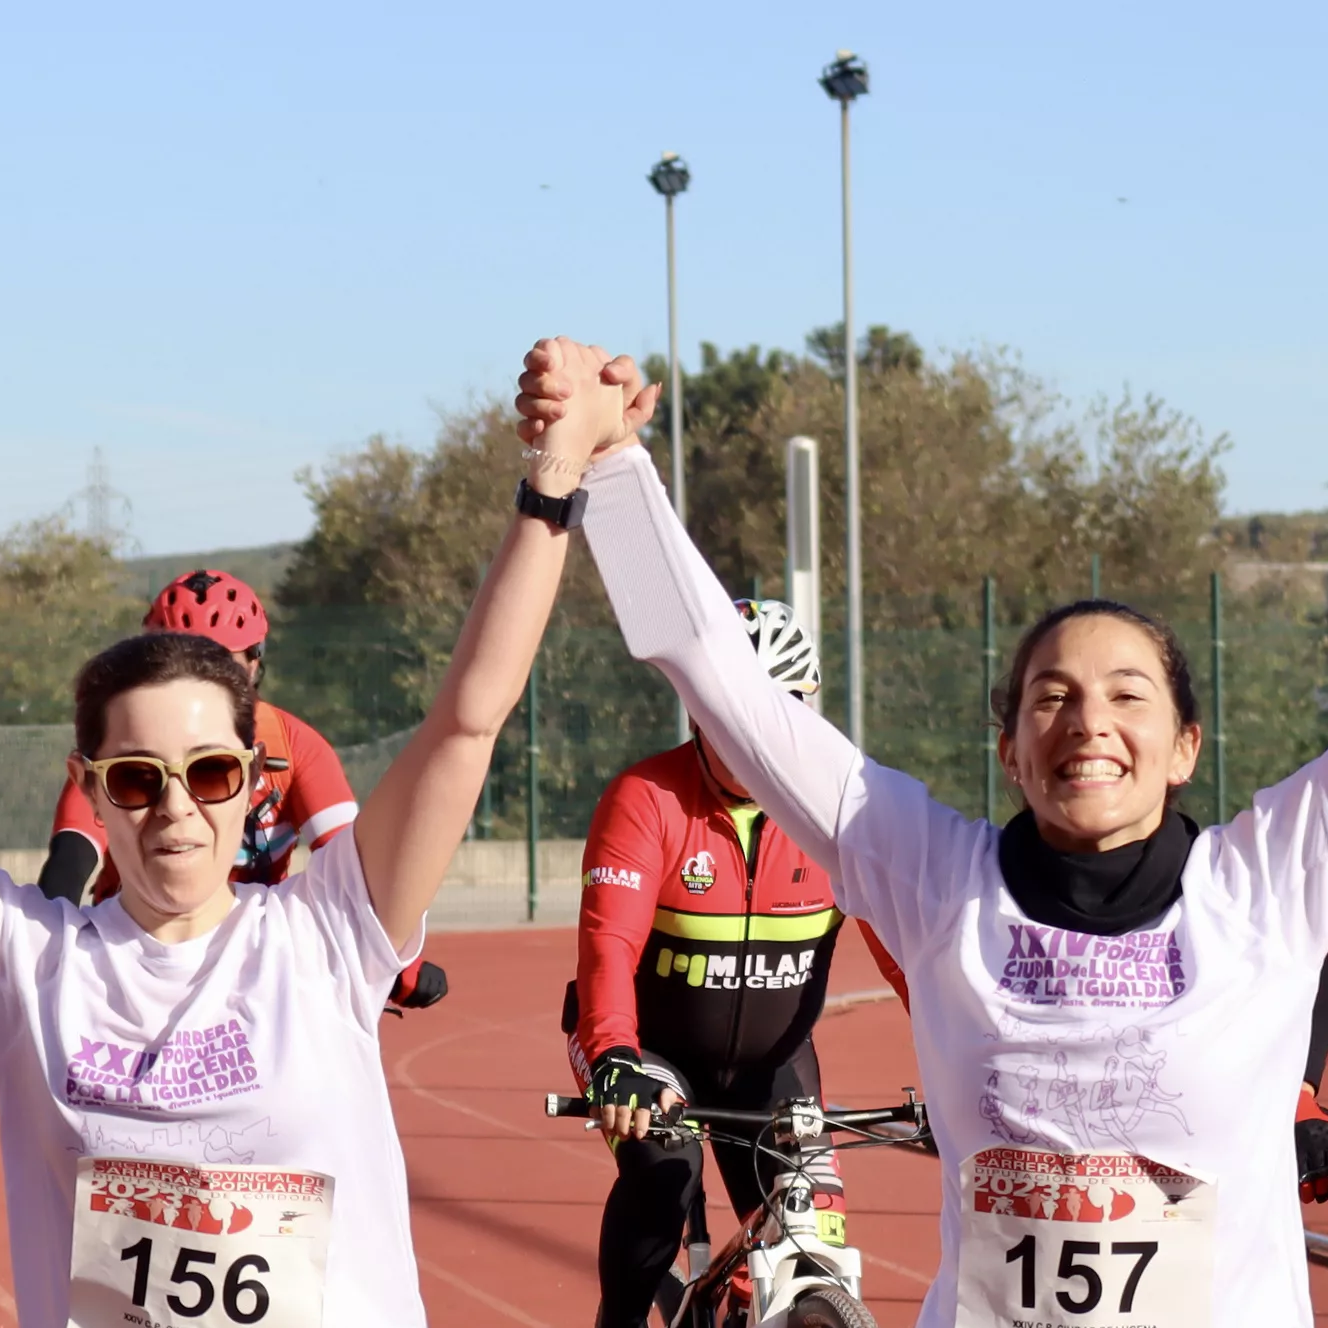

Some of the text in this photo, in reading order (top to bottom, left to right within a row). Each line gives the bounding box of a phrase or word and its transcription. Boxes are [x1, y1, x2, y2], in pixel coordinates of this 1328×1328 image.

[1007, 925, 1093, 959] XXIV
[1093, 942, 1183, 965] POPULAR
[706, 949, 815, 978] MILAR
[1003, 959, 1185, 982] CIUDAD de LUCENA
[704, 970, 813, 990] LUCENA
[1045, 980, 1067, 997] LA
[1077, 980, 1186, 999] IGUALDAD
[161, 1033, 249, 1065] POPULAR
[160, 1046, 255, 1085] LUCENA
[66, 1078, 107, 1101] POR
[115, 1086, 144, 1104] LA
[152, 1066, 258, 1101] IGUALDAD
[93, 1166, 325, 1196] CARRERAS POPULARES
[974, 1156, 1078, 1176] CARRERAS
[90, 1179, 184, 1210] 2023
[973, 1175, 1061, 1201] 2023
[119, 1236, 271, 1325] 156
[1005, 1234, 1159, 1315] 157
